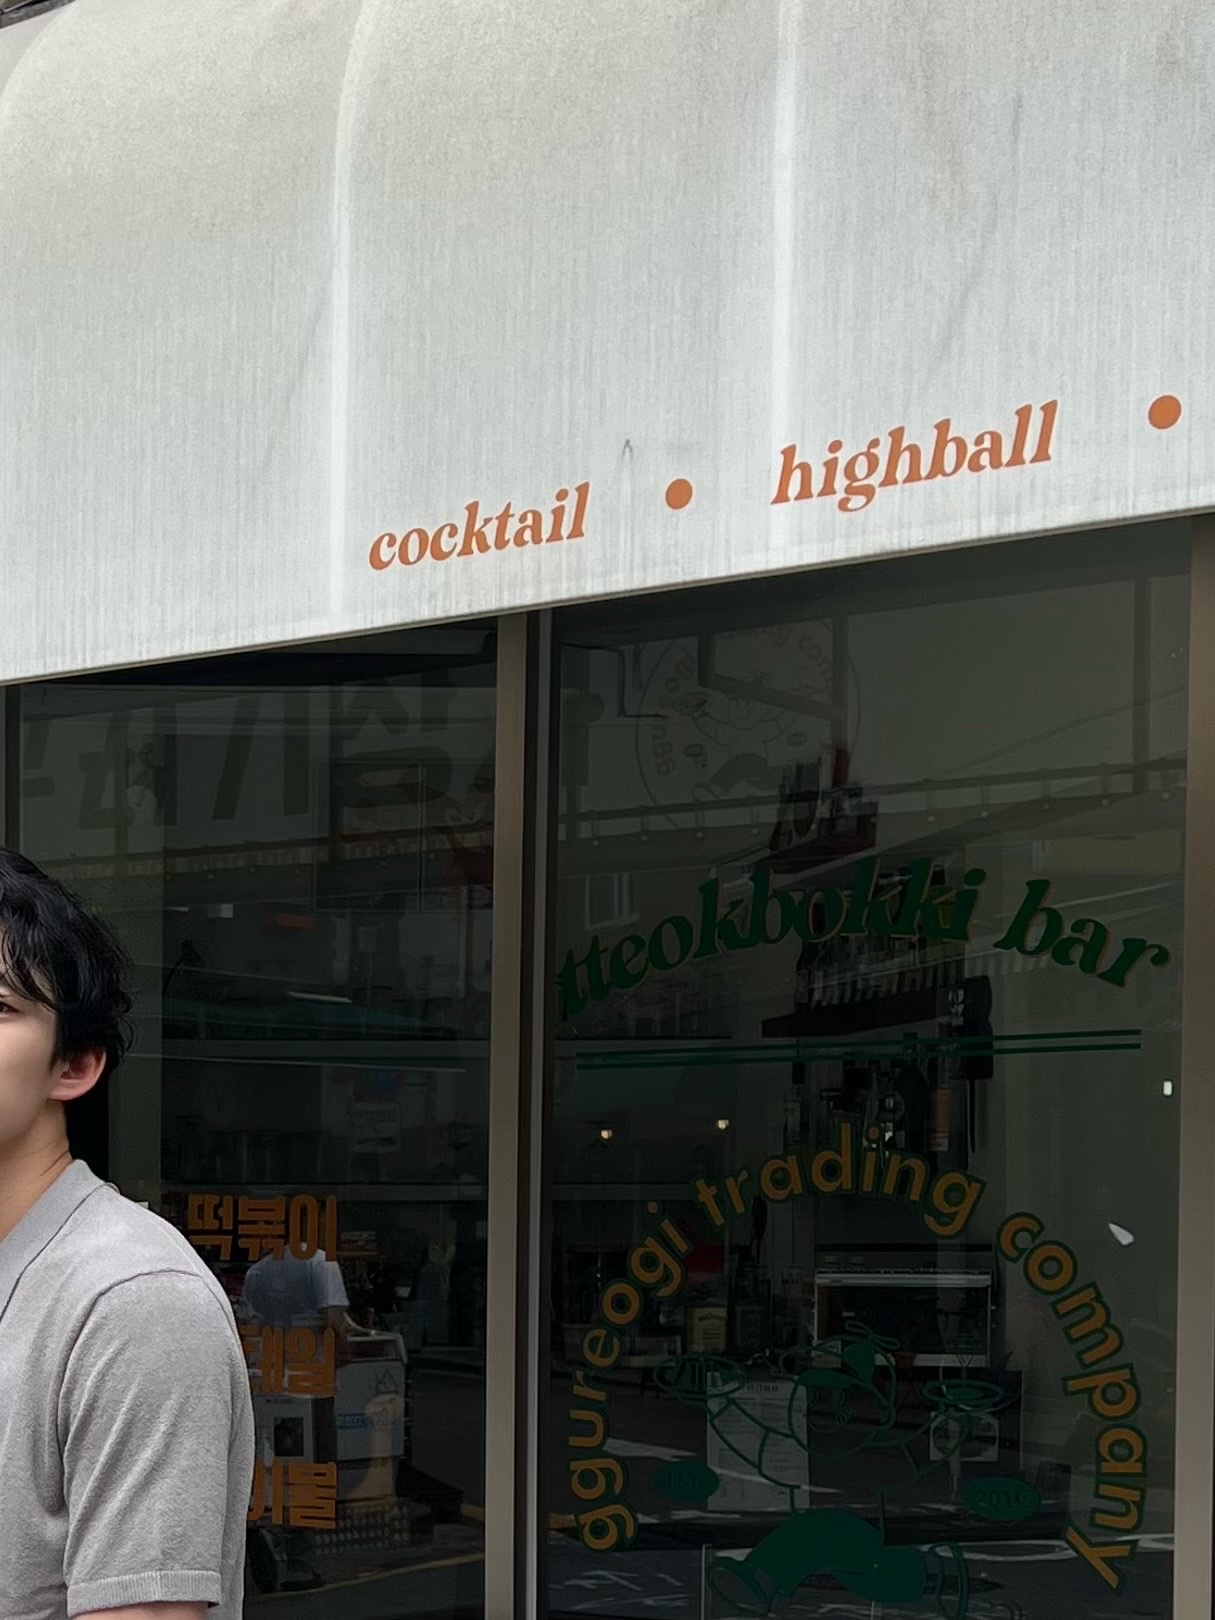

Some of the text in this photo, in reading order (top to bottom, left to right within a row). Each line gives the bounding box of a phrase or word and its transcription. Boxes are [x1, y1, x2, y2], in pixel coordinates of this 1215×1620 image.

[770, 400, 1058, 513] highball
[368, 482, 590, 571] cocktail
[556, 856, 1171, 1020] tteokbokki bar
[187, 1194, 338, 1262] 떡볶이
[567, 1122, 1147, 1593] ggureogi trading company
